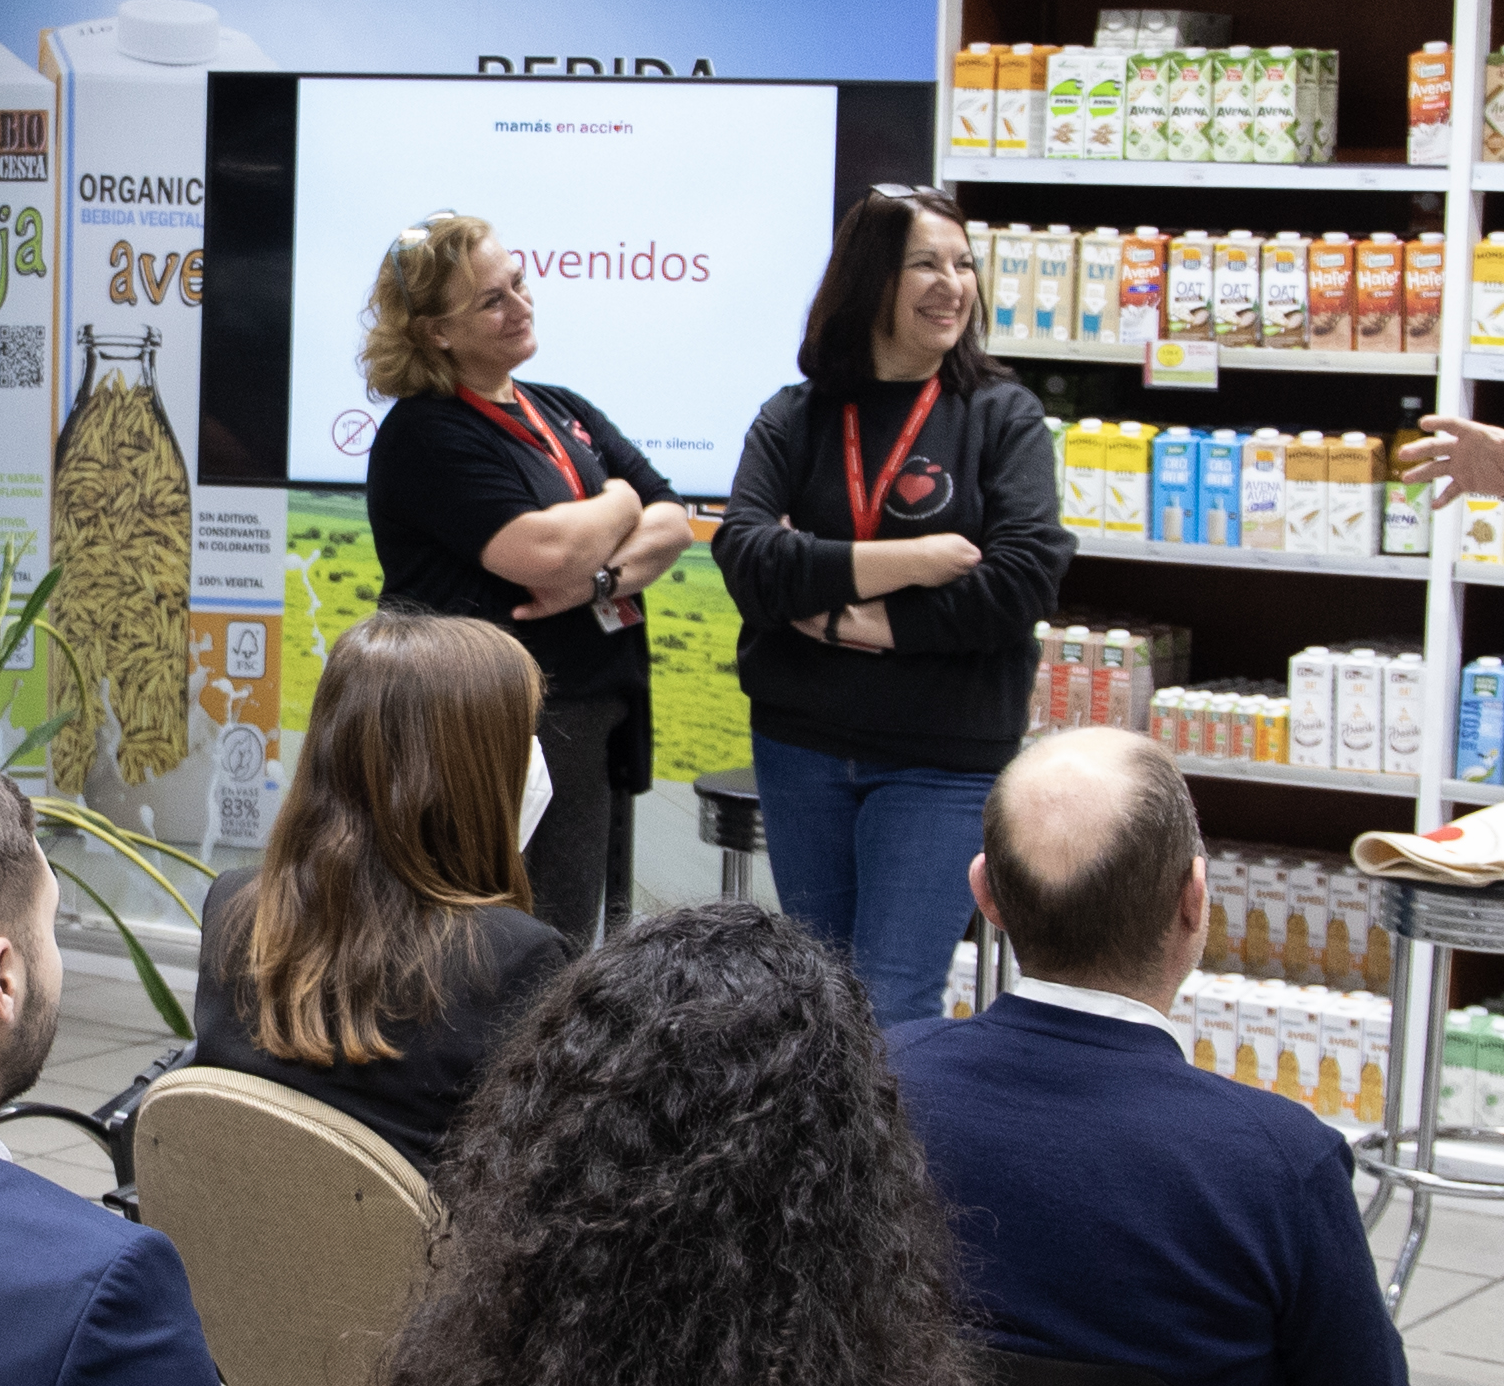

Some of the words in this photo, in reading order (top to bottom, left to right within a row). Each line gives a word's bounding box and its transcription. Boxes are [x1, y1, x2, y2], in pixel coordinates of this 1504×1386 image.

[1410, 81, 1452, 98] Avena
[495, 119, 552, 133] mamás
[556, 123, 575, 133] en
[79, 173, 204, 205] ORGANIC
[81, 208, 136, 225] BEBIDA
[140, 210, 204, 228] VEGETAL
[109, 239, 204, 307] ave
[1176, 281, 1205, 296] OAT
[1221, 283, 1251, 298] OAT
[1269, 285, 1299, 299] OAT
[647, 440, 662, 449] en
[666, 437, 715, 451] silencio
[1246, 480, 1282, 492] AVENA
[199, 512, 215, 523] SIN
[199, 527, 271, 539] CONSERVANTES
[199, 542, 208, 551] NI
[210, 542, 271, 554] COLORANTES
[198, 576, 223, 587] 100%
[225, 577, 264, 588] VEGETAL
[222, 798, 261, 819] 83%
